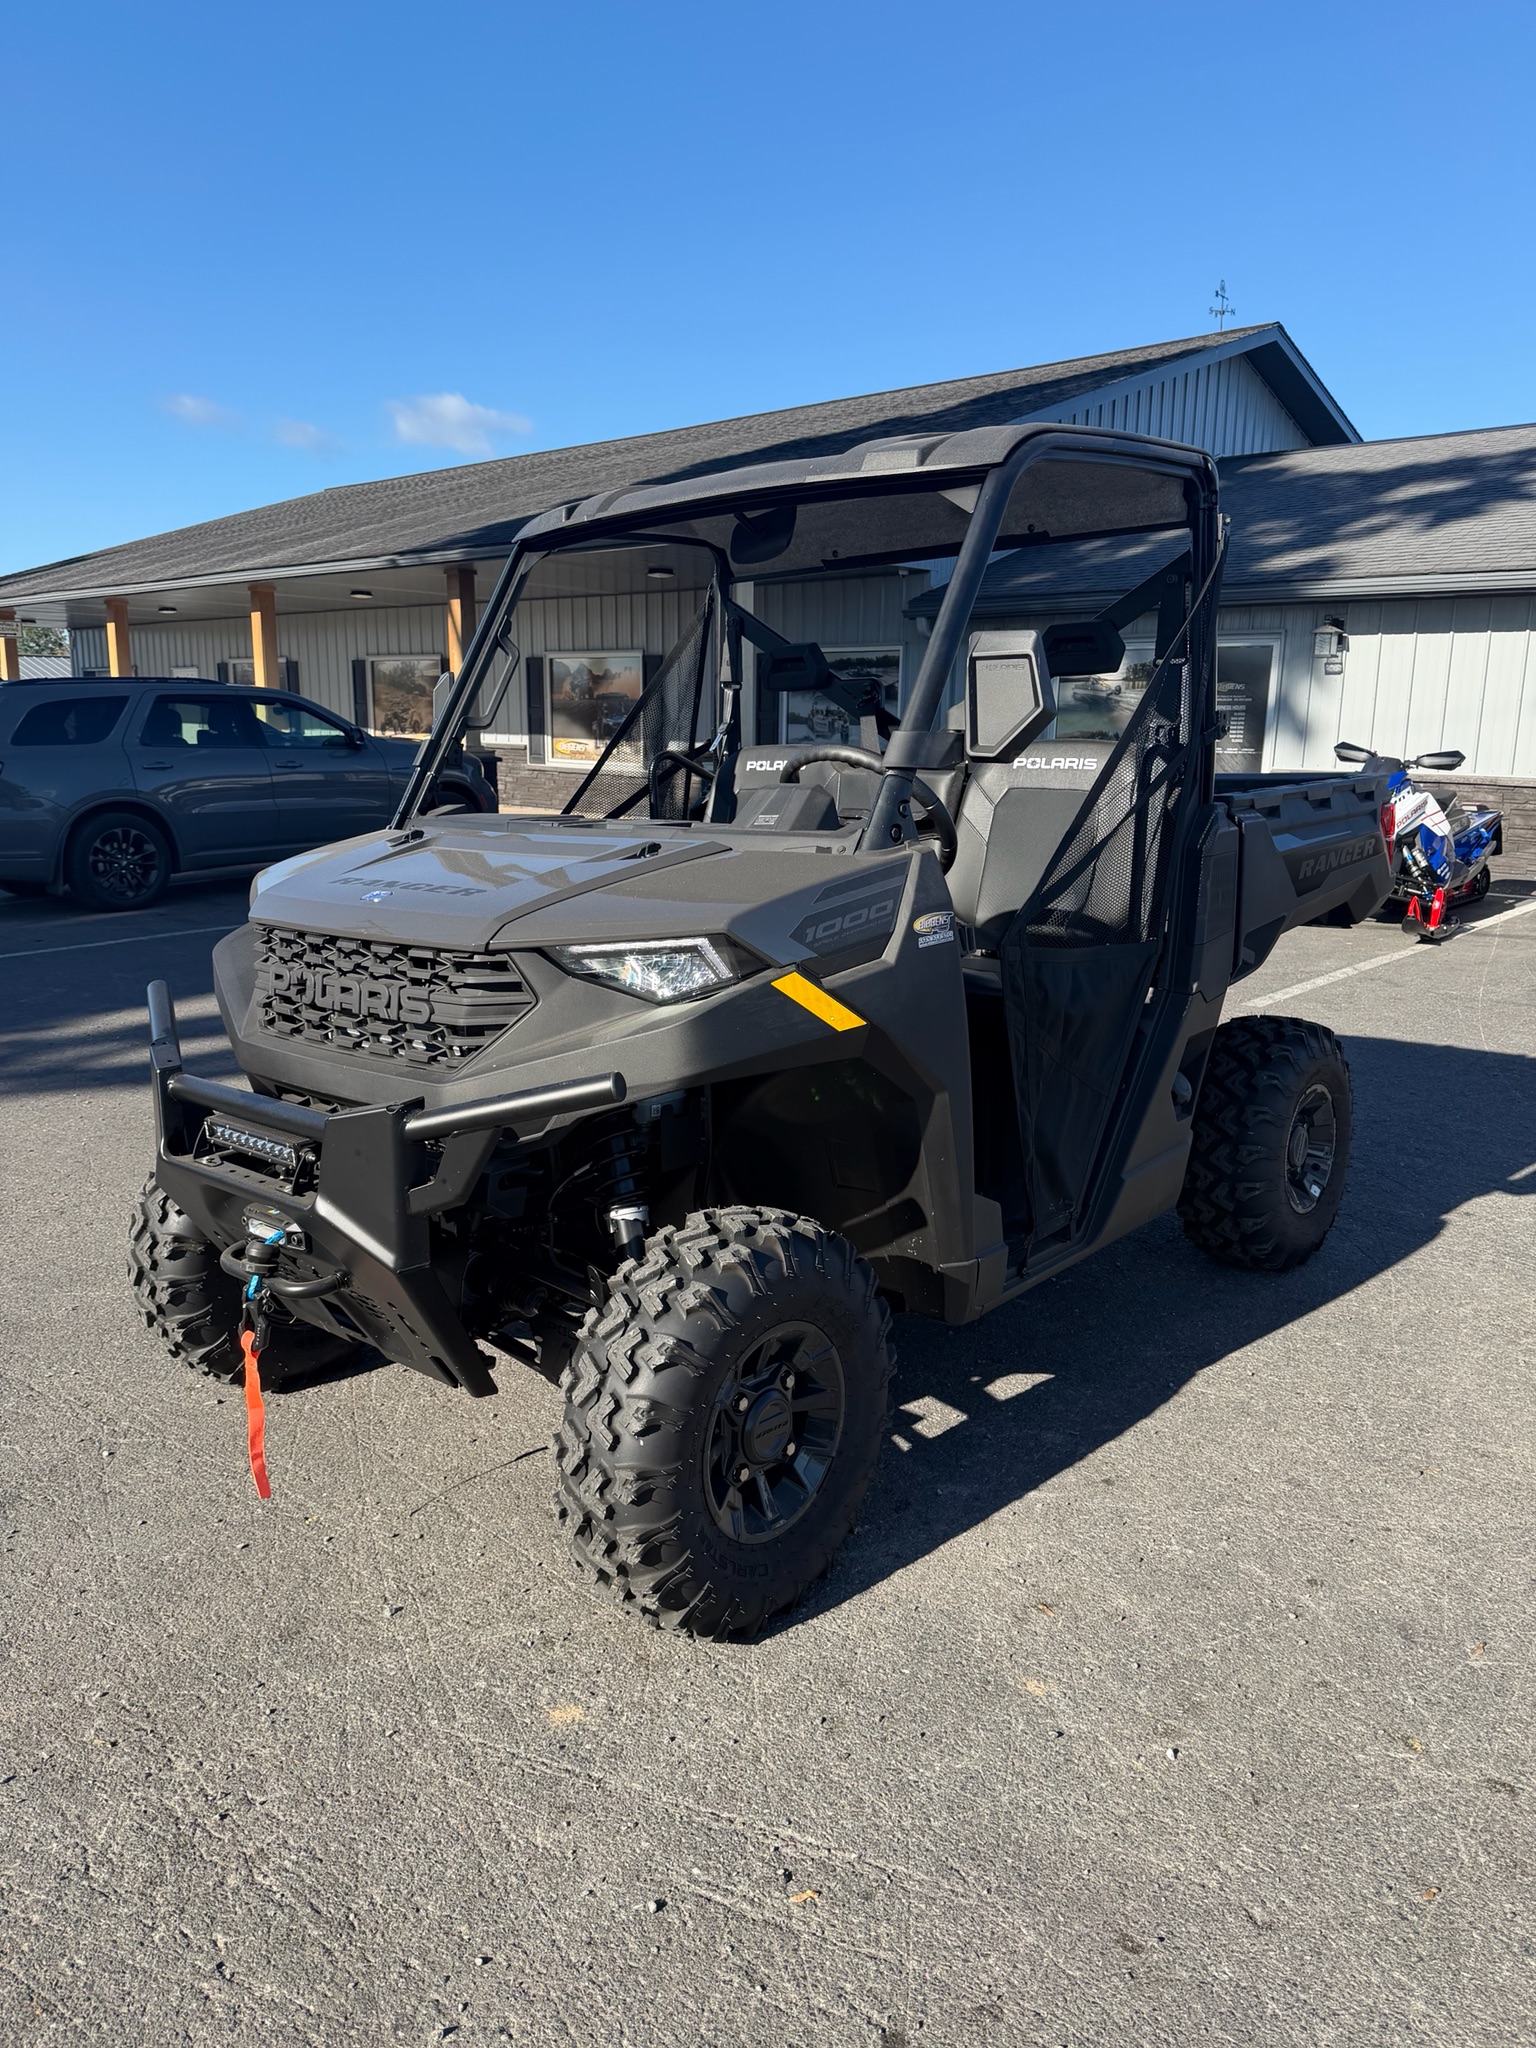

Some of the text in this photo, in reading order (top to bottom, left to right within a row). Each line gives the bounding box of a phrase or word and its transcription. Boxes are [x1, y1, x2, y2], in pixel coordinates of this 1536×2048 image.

[746, 760, 807, 771] POLA
[1012, 757, 1098, 770] POLARIS
[1396, 800, 1428, 830] POLARIS
[1298, 838, 1376, 880] RANGER
[327, 877, 488, 897] RANGER
[805, 899, 894, 943] 1000
[269, 965, 432, 1025] POLARIS
